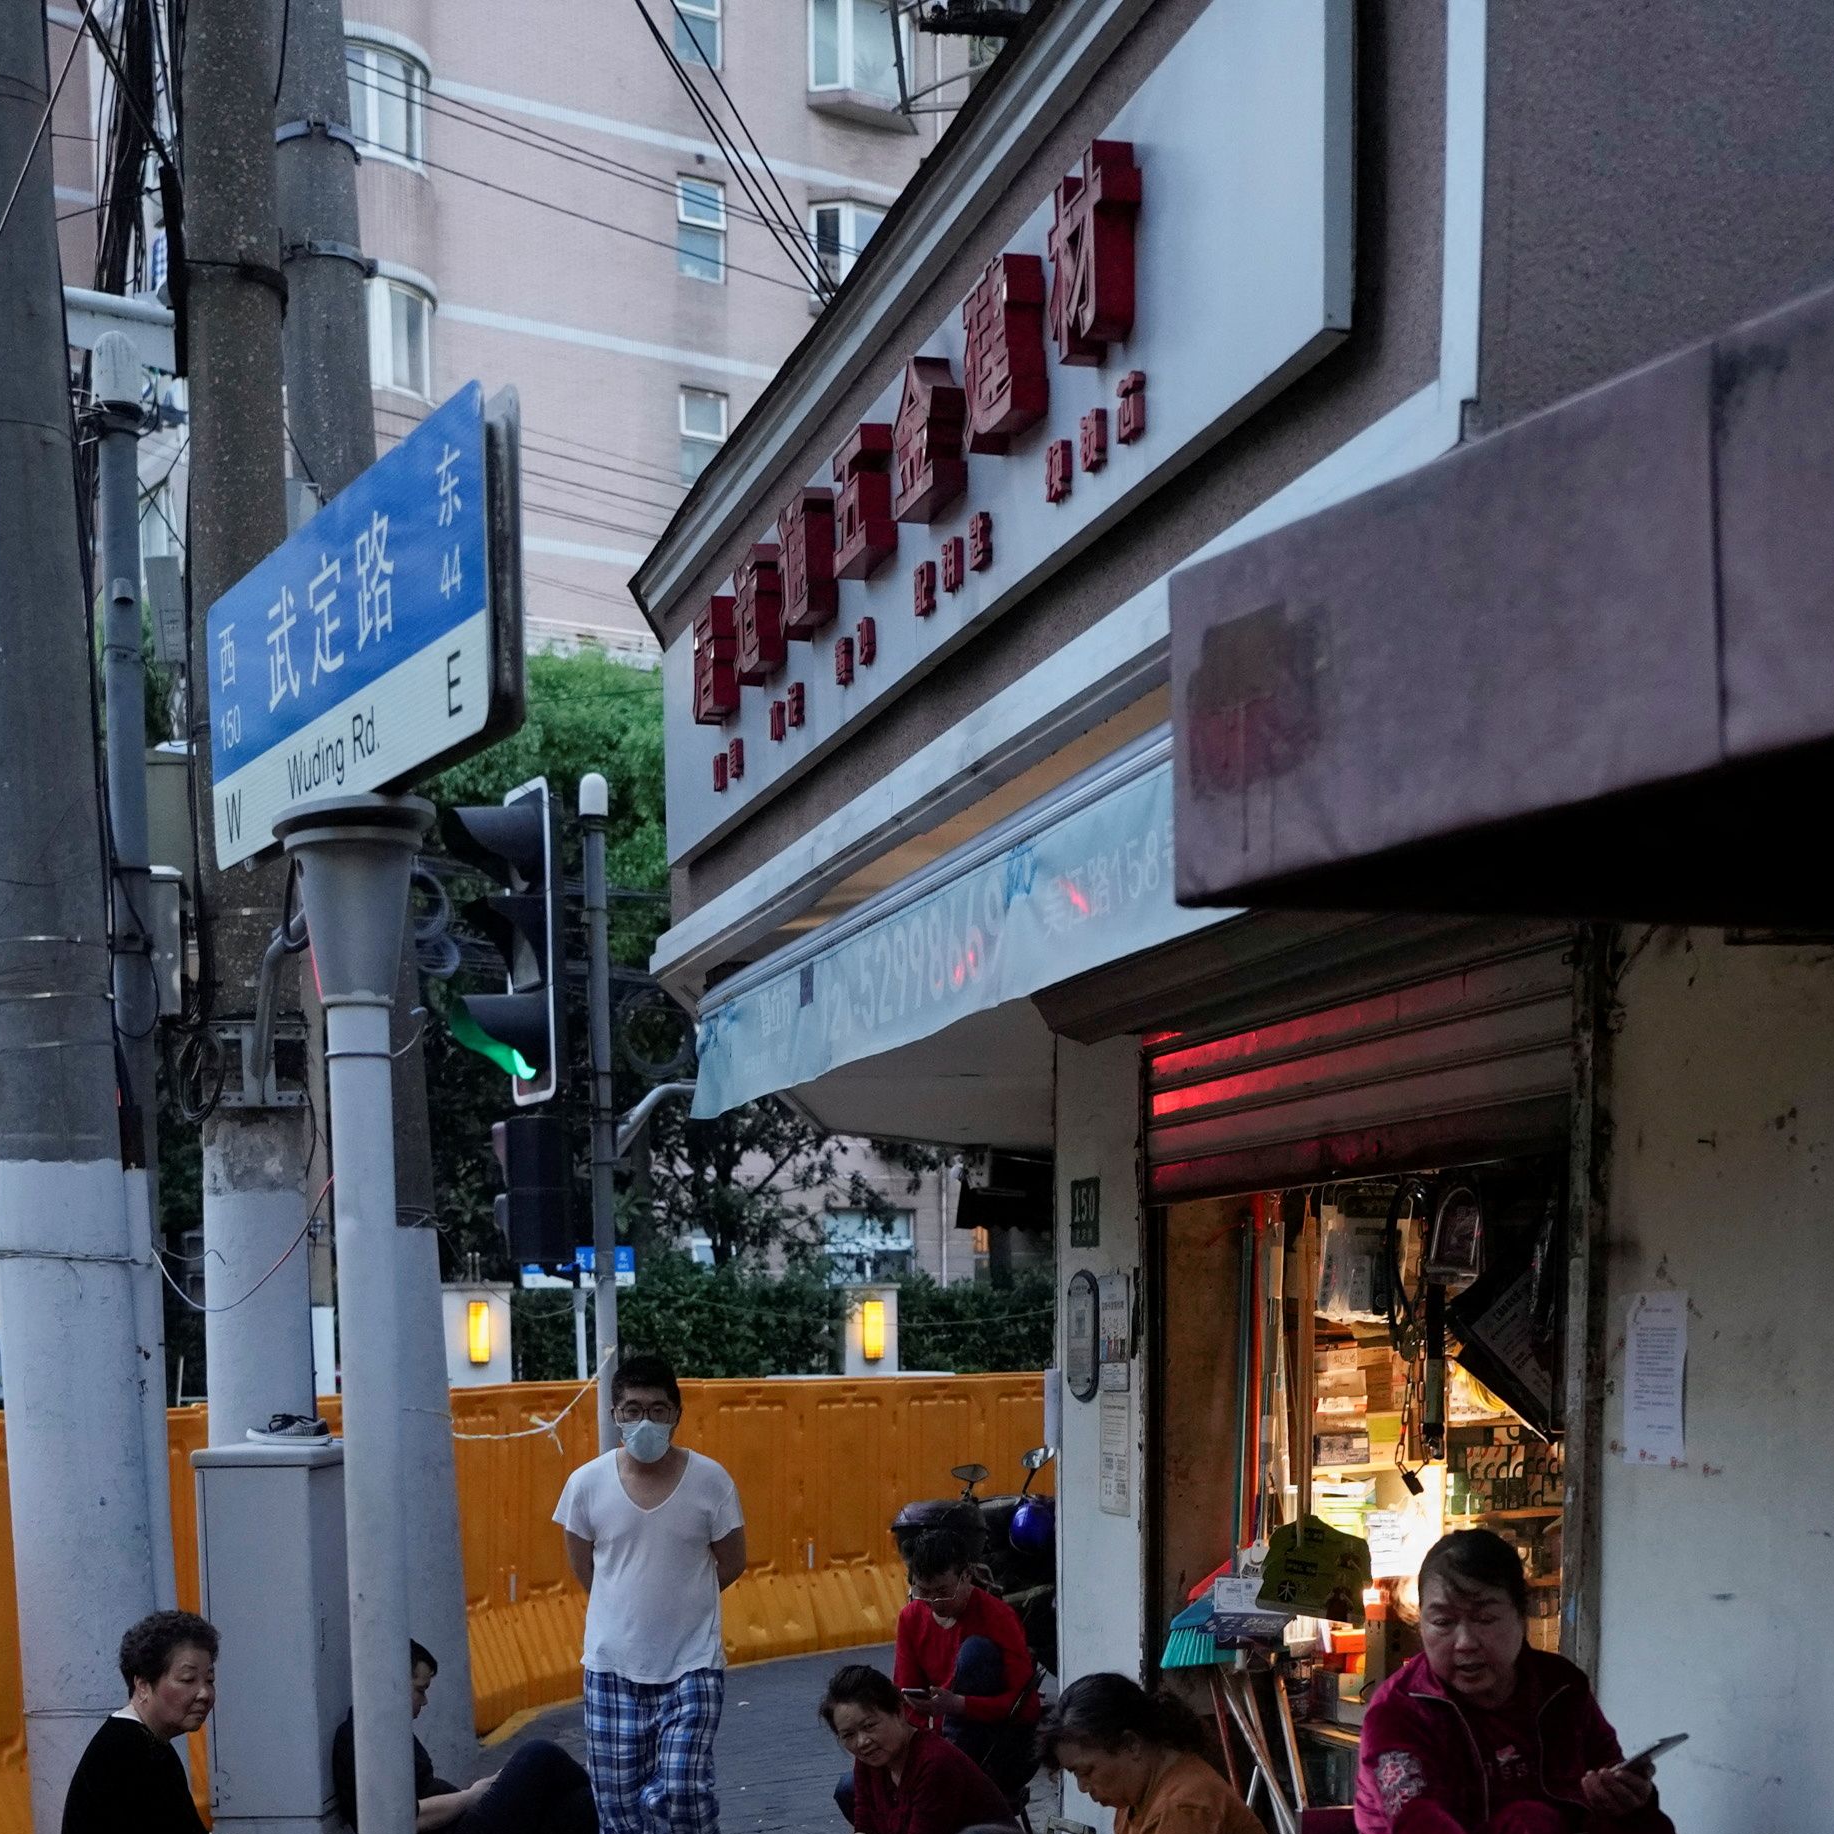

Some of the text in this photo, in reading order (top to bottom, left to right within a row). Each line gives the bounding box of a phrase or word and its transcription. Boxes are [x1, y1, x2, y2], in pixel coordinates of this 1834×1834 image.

[435, 444, 462, 527] 东
[439, 545, 463, 600] 44
[914, 511, 993, 616] 配钥匙
[266, 511, 395, 714] 武定路
[218, 622, 237, 693] 西
[447, 651, 464, 718] E
[220, 707, 242, 752] 150
[287, 706, 381, 799] Wuding Rd.
[225, 790, 243, 844] W
[1074, 1186, 1096, 1223] 150
